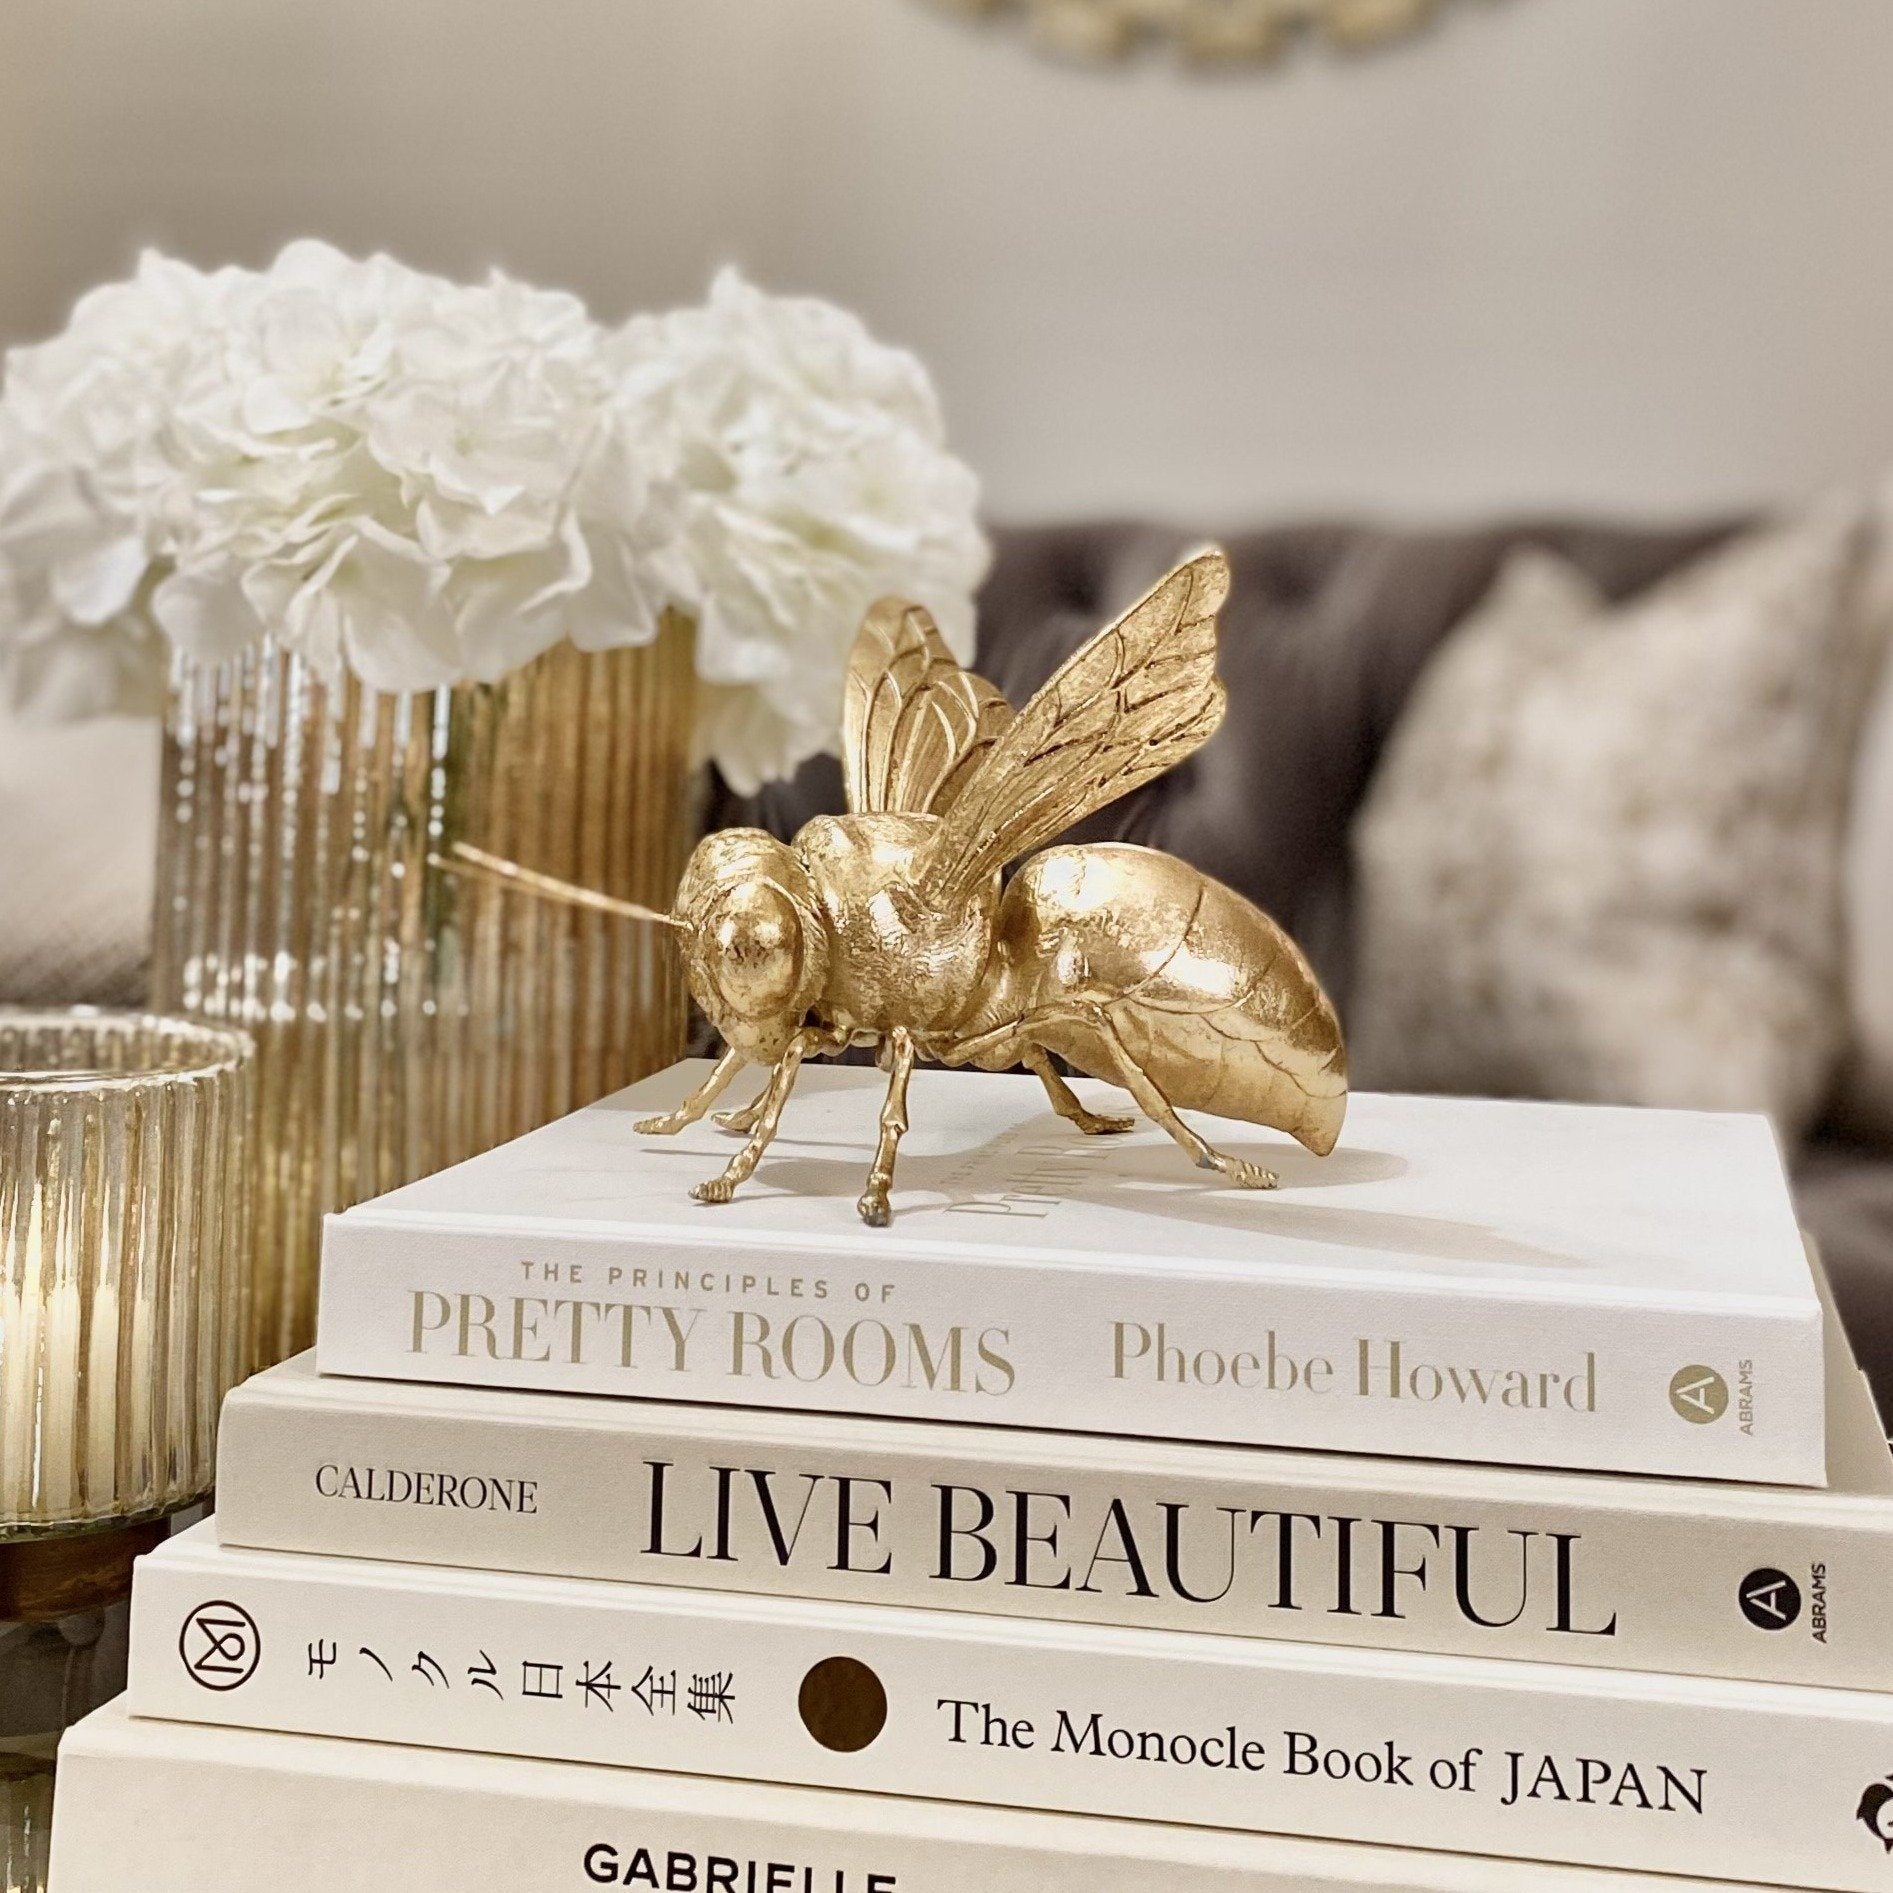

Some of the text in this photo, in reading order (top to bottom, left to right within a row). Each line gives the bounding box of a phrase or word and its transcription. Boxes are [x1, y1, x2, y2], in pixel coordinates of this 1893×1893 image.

[521, 1261, 896, 1304] THE PRINCIPLES OF
[406, 1289, 1016, 1396] PRETTY ROOMS
[1109, 1321, 1596, 1413] Phoebe Howard
[1738, 1359, 1755, 1437] ABRAMS
[316, 1465, 538, 1514] CALDERONE
[641, 1461, 1617, 1637] LIVE BEAUTIFUL
[1811, 1562, 1827, 1645] ABRAMS
[306, 1637, 736, 1725] モノクル日本全集
[937, 1699, 1708, 1815] The Monocle Book of JAPAN
